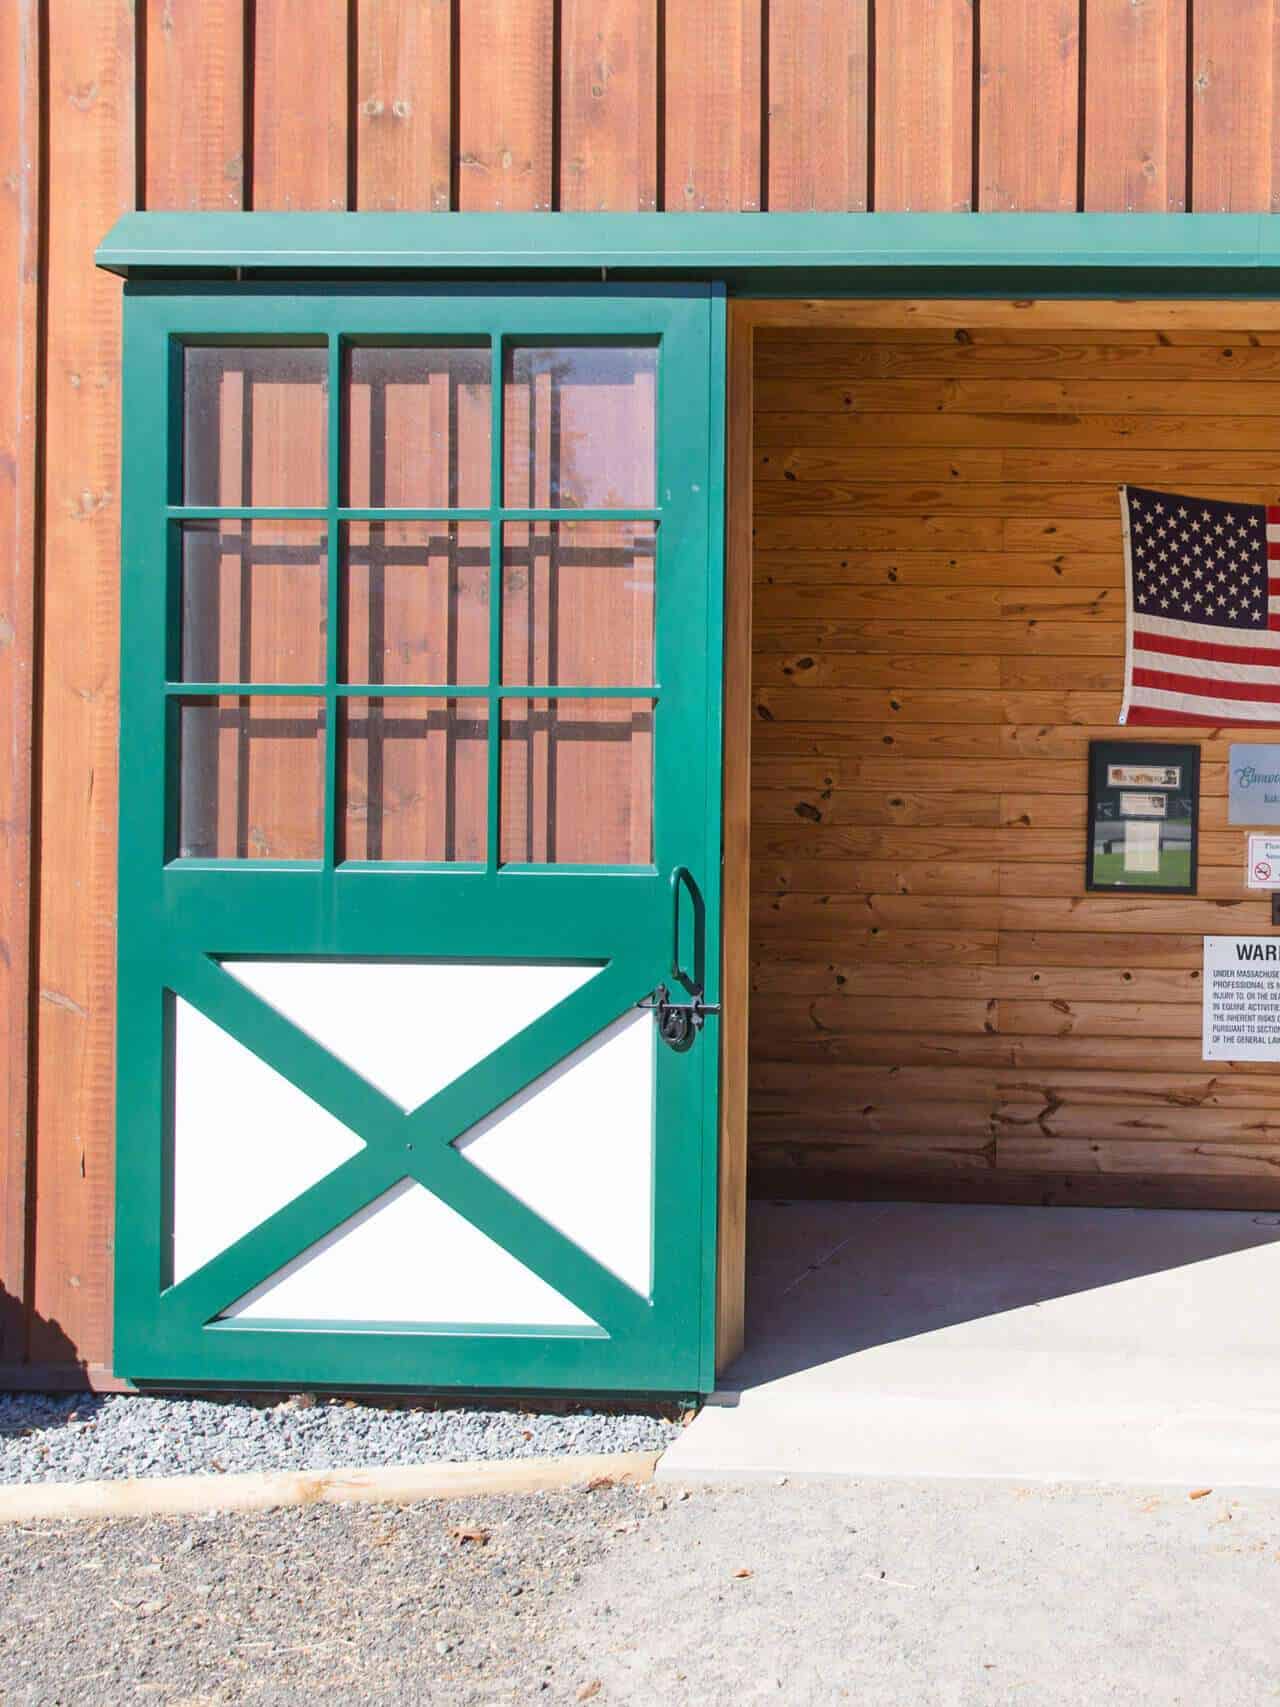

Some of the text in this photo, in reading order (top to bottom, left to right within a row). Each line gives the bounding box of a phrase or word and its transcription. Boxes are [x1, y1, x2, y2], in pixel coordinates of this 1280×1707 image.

[1212, 970, 1235, 978] UNDER
[1212, 981, 1264, 990] PROFESSIONAL
[1267, 981, 1275, 990] IS
[1213, 991, 1234, 1000] INJURY
[1246, 992, 1256, 1001] OR
[1257, 992, 1269, 1001] THE
[1212, 1003, 1220, 1011] IN
[1222, 1003, 1245, 1011] EQUINE
[1213, 1014, 1225, 1022] THE
[1226, 1014, 1256, 1023] INHERENT
[1257, 1014, 1276, 1023] RISKS
[1212, 1024, 1245, 1033] PURSUANT
[1247, 1025, 1255, 1033] TO
[1212, 1035, 1221, 1043] OF
[1223, 1035, 1235, 1044] THE
[1236, 1035, 1266, 1045] GENERAL
